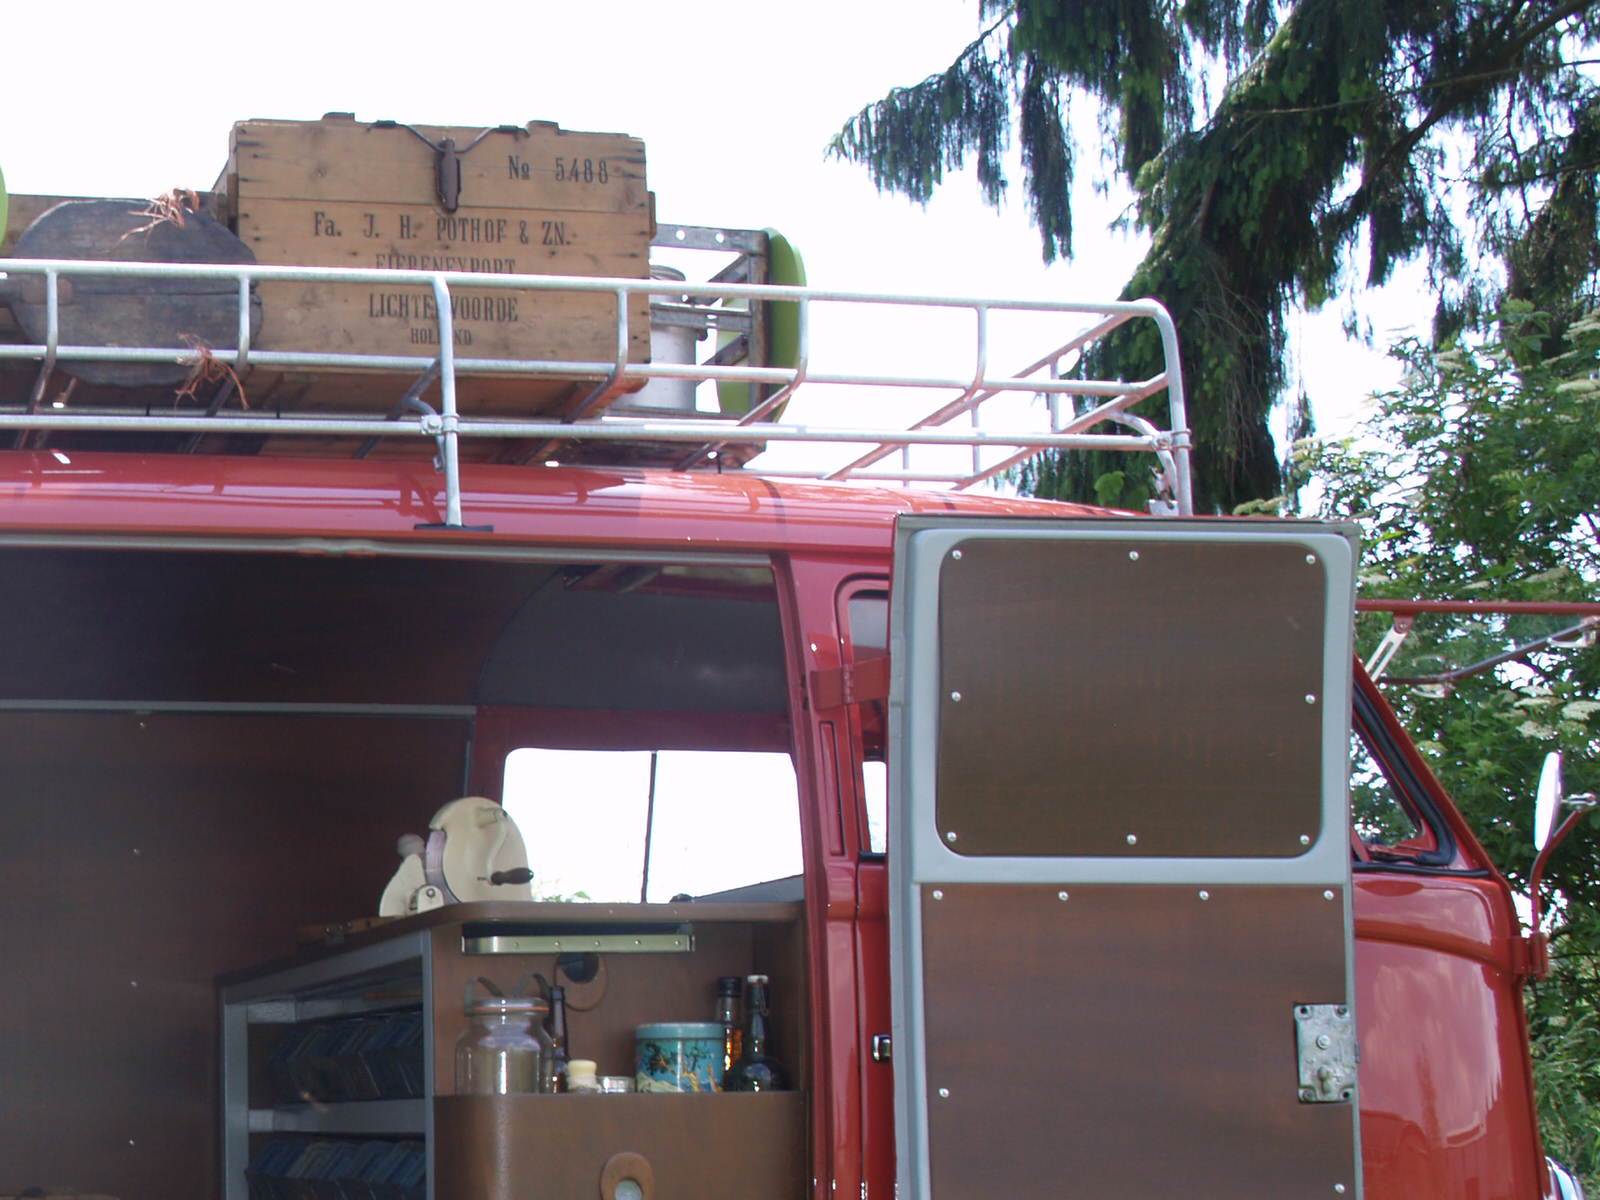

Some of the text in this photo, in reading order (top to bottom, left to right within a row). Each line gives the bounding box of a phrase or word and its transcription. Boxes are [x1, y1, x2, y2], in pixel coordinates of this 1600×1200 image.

[314, 211, 342, 237] Fa.
[437, 216, 506, 243] POTHOF
[519, 220, 529, 244] &
[410, 327, 473, 346] HOLND
